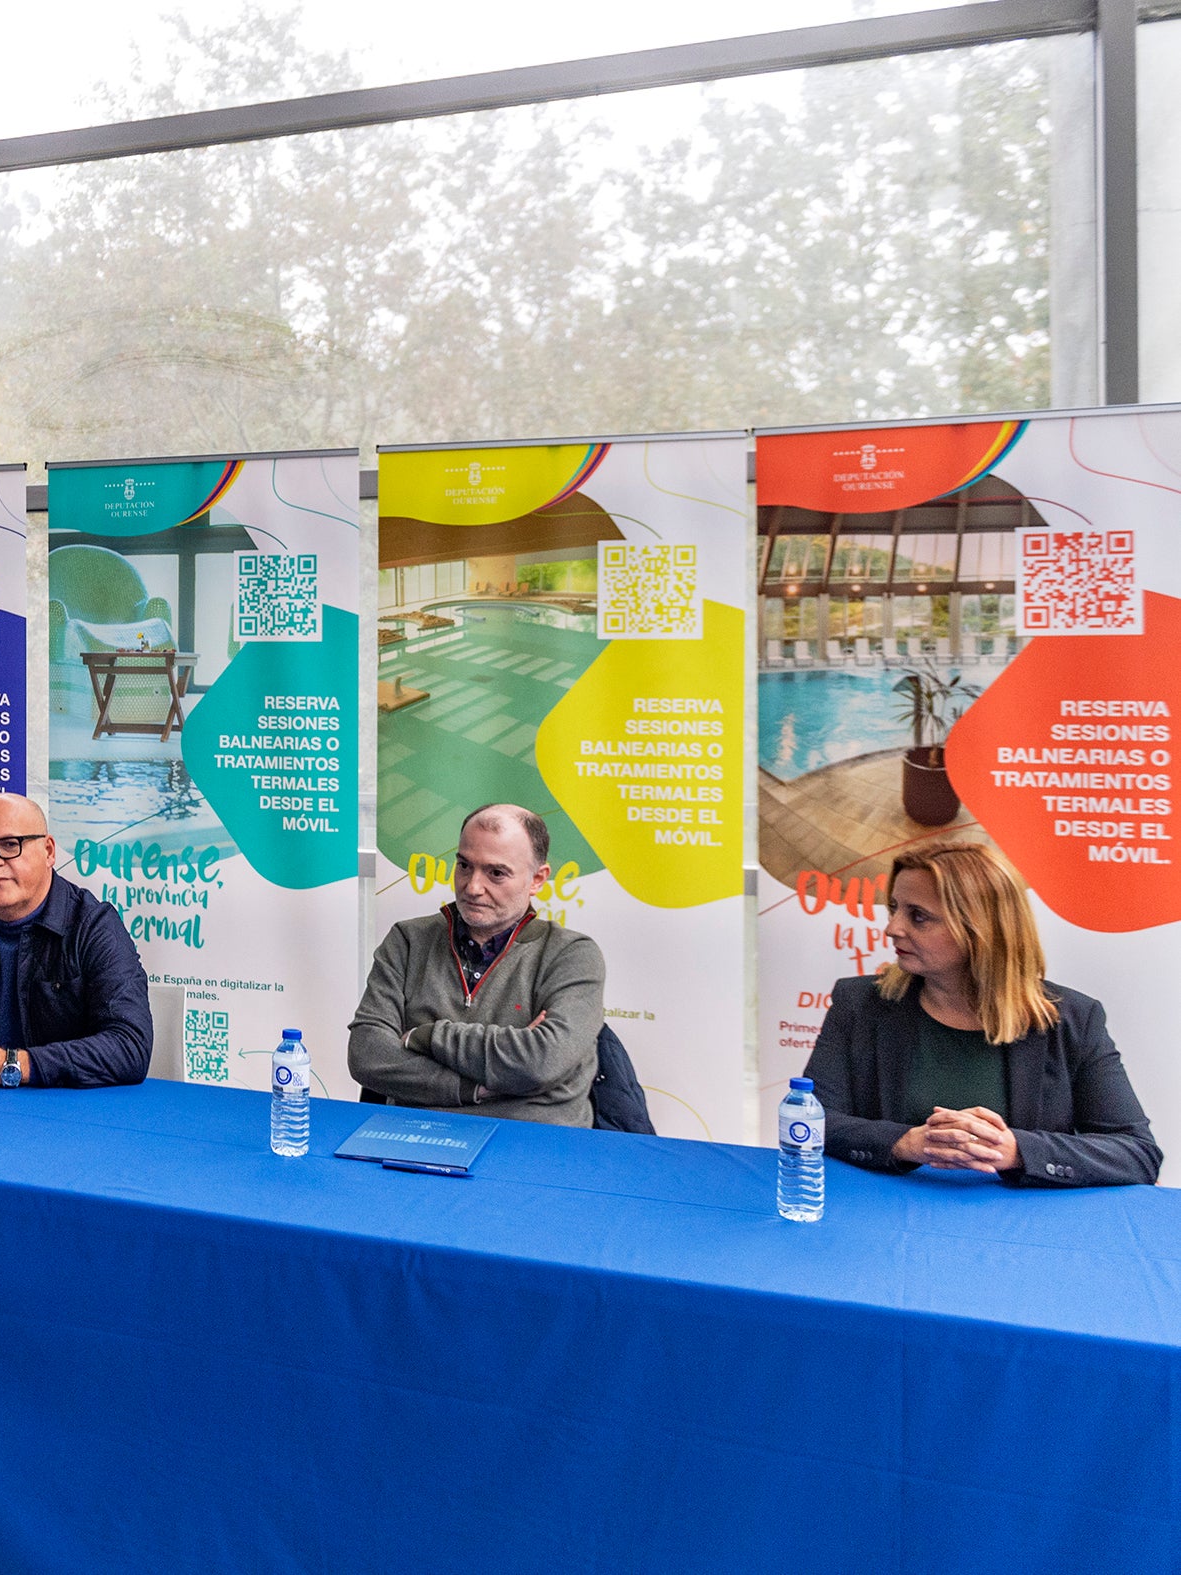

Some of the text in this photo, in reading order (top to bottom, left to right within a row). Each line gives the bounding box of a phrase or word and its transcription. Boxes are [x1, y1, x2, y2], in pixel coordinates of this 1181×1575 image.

[833, 470, 905, 482] DEPUTACIÓN
[445, 485, 506, 497] DEPUTACIÓN
[841, 481, 896, 491] OURENSE
[104, 500, 155, 510] DEPUTACIÓN
[452, 496, 499, 505] OURENSE
[110, 510, 148, 518] OURENSE
[264, 696, 340, 710] RESERVA
[633, 698, 723, 714] RESERVA
[1060, 700, 1171, 717] RESERVA
[258, 716, 339, 730] SESIONES
[625, 720, 723, 736] SESIONES
[0, 731, 10, 743] O
[1050, 724, 1171, 742] SESIONES
[219, 735, 339, 751] BALNEARIAS O
[580, 741, 723, 758] BALNEARIAS O
[214, 755, 339, 771] TRATAMIENTOS
[997, 747, 1171, 767] BALNEARIAS O
[574, 762, 723, 780] TRATAMIENTOS
[251, 776, 339, 792] TERMALES
[990, 771, 1171, 790] TRATAMIENTOS
[617, 785, 723, 802] TERMALES
[260, 796, 339, 812] DESDE EL
[1041, 796, 1171, 815] TERMALES
[283, 814, 339, 832] MÓVIL.
[627, 807, 723, 824] DESDE EL
[655, 826, 723, 846] MÓVIL.
[1054, 820, 1172, 840] DESDE EL
[1088, 842, 1171, 864] MÓVIL.
[75, 838, 223, 889] Ourense,
[102, 883, 208, 909] la provincia
[834, 924, 854, 950] la
[148, 974, 284, 992] de España en digitalizar la
[644, 1010, 655, 1020] la
